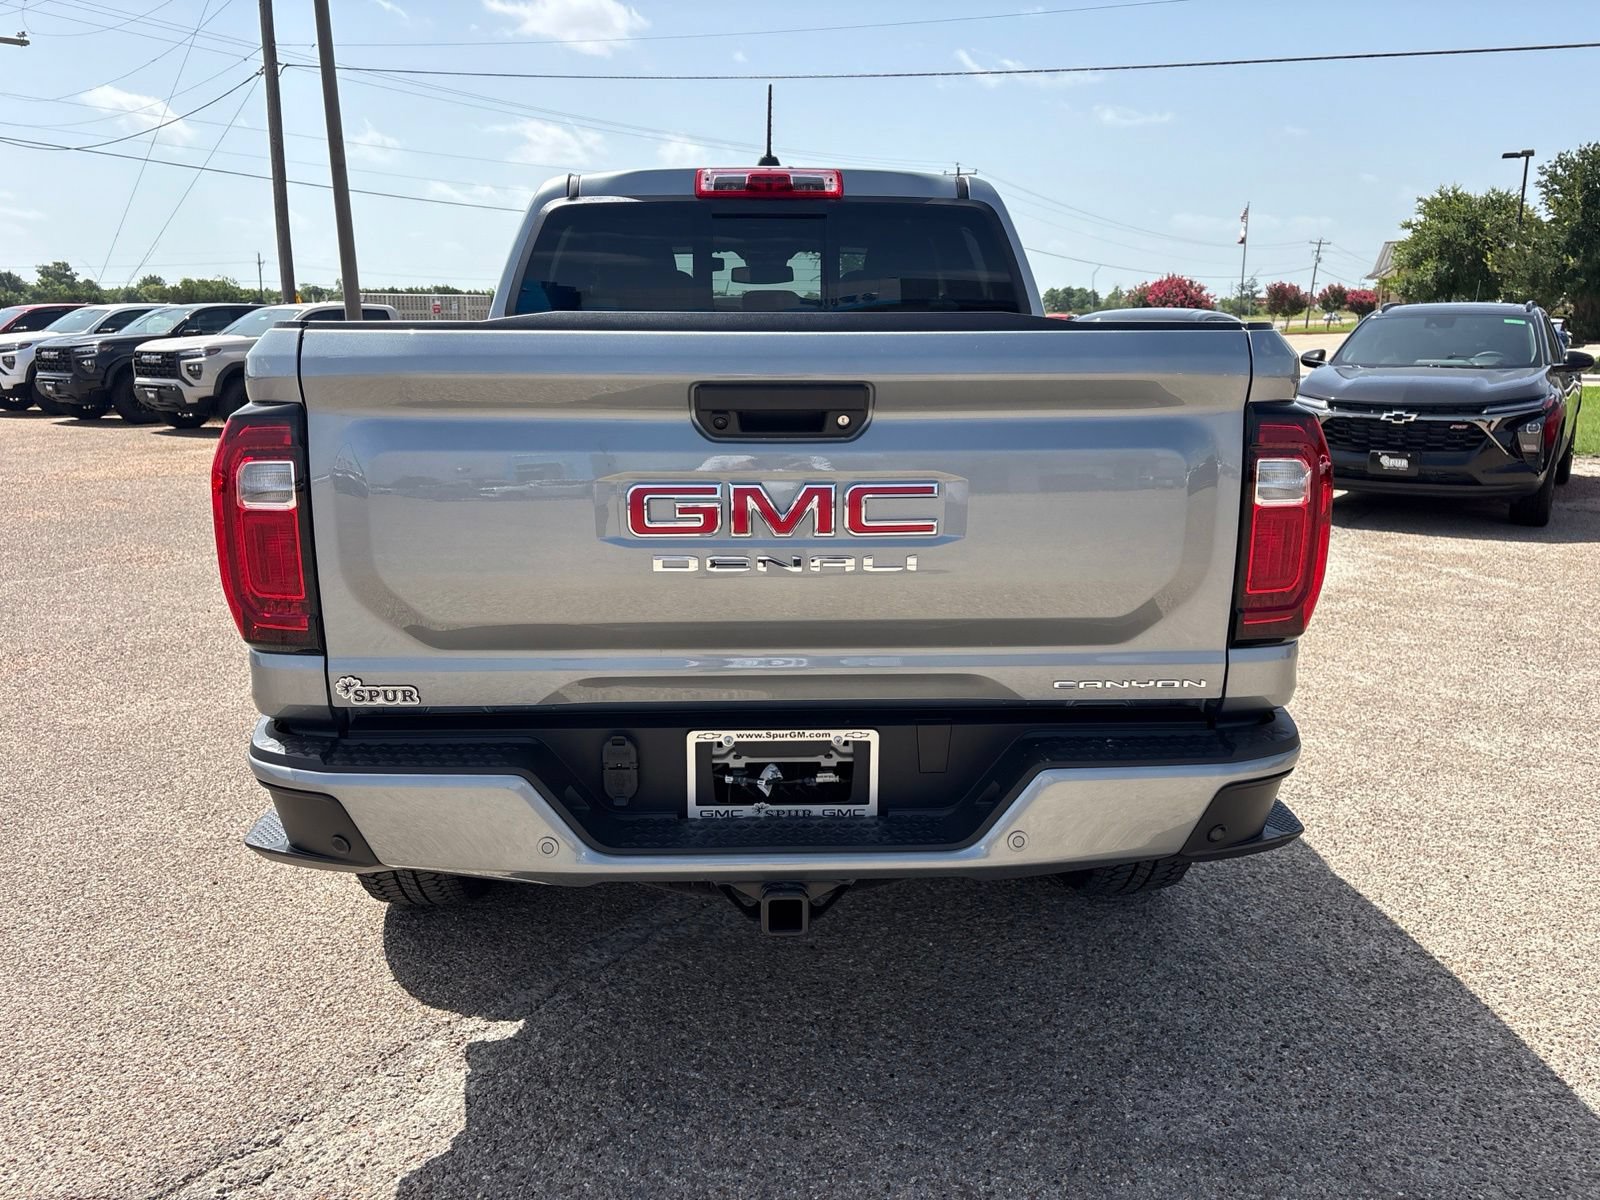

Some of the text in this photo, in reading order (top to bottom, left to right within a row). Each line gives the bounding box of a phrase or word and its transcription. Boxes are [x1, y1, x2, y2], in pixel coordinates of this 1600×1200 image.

[626, 481, 939, 538] GMC
[652, 553, 918, 573] DENALI
[1053, 679, 1207, 689] CANYON
[353, 688, 417, 703] SPUR
[736, 731, 831, 741] www.SpurGM.com
[699, 809, 744, 818] GMC
[821, 808, 866, 817] GMC
